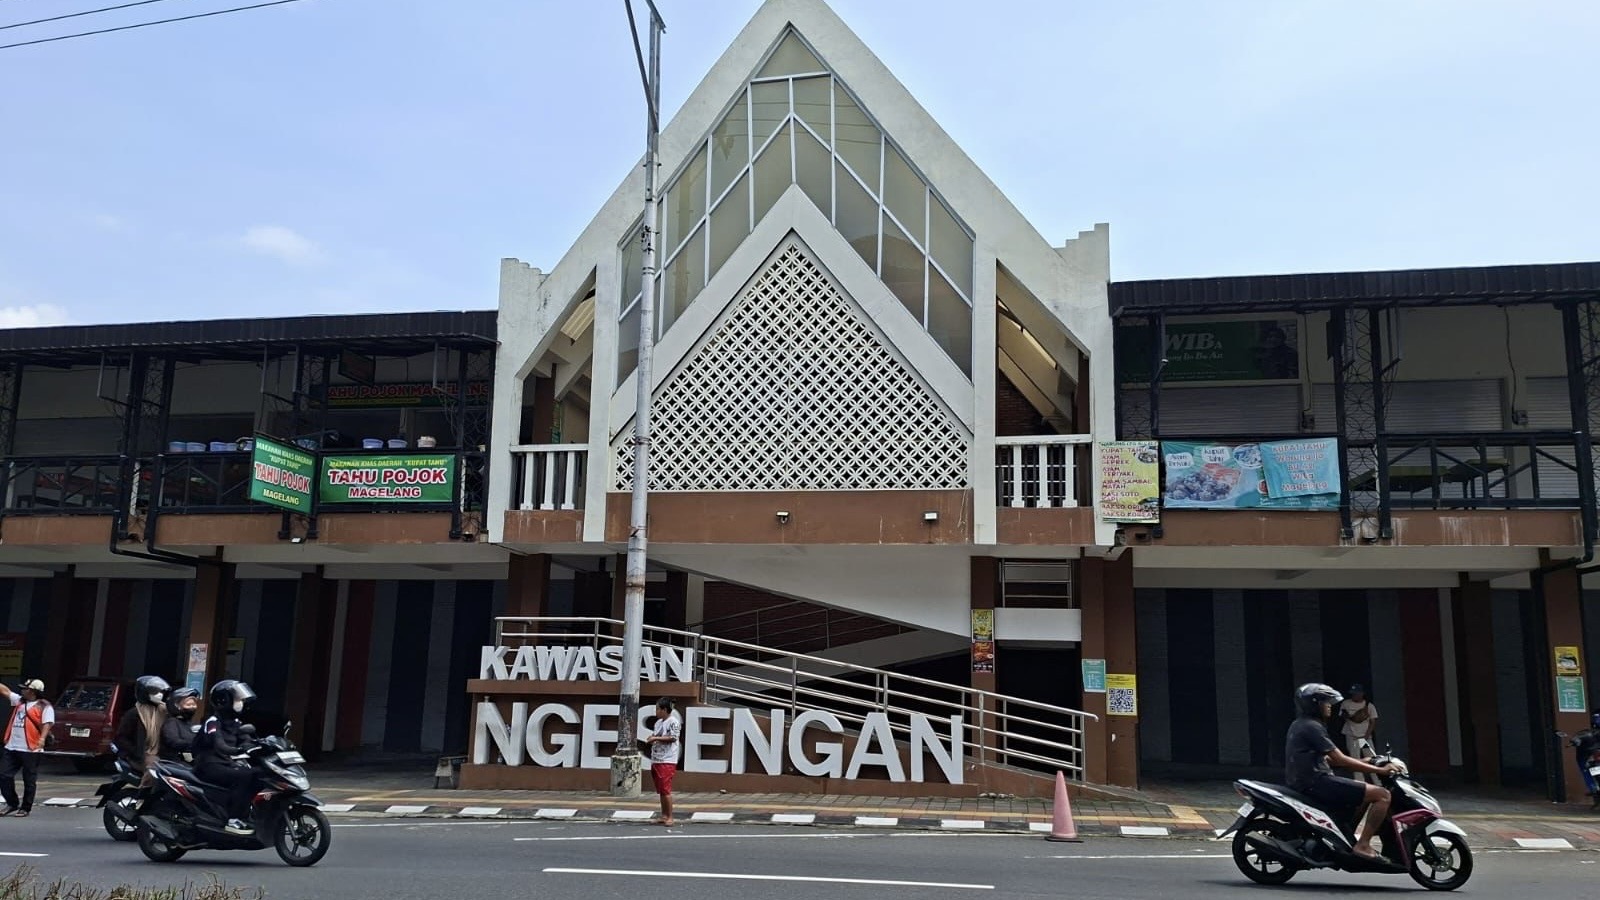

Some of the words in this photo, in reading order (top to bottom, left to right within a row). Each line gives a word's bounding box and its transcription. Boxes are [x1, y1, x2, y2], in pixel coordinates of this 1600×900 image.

[328, 386, 358, 399] AHU
[359, 384, 407, 398] POJOK
[255, 461, 281, 485] TAHU
[281, 470, 311, 494] POJOK
[328, 469, 378, 485] TAHU
[381, 468, 447, 484] POJOK
[263, 488, 300, 505] MAGELANG
[348, 487, 421, 498] MAGELANG
[479, 645, 695, 682] KAWASAN
[473, 701, 964, 785] NGESENGAN
